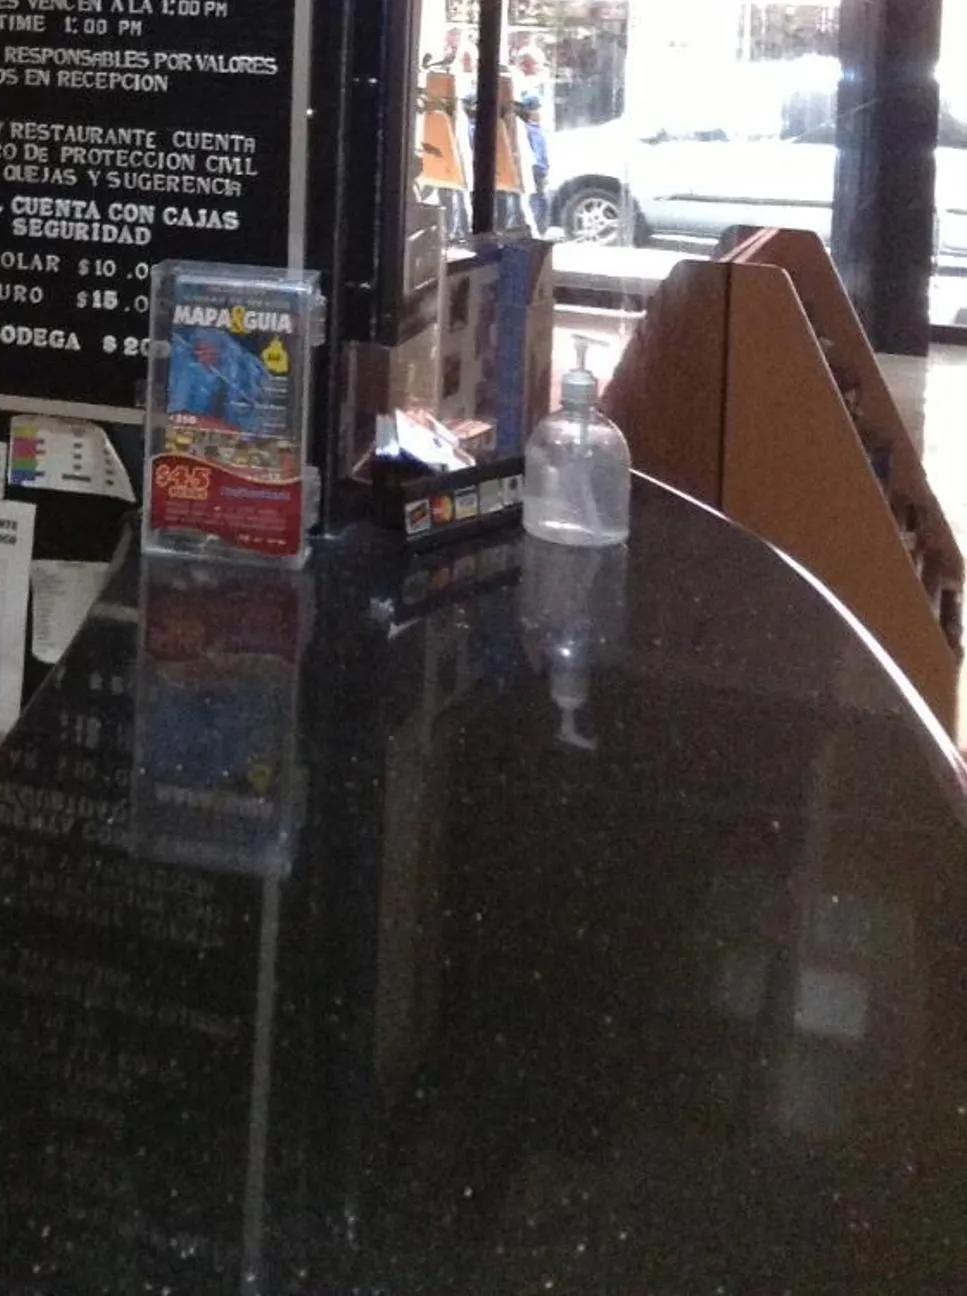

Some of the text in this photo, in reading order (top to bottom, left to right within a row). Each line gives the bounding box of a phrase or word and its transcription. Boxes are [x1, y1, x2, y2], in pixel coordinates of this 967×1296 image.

[204, 1, 228, 17] PM
[119, 20, 143, 36] PM
[4, 44, 149, 69] RESPONSABLES
[154, 53, 194, 72] POR
[196, 54, 277, 75] VALORES
[25, 67, 51, 86] EN
[57, 70, 169, 92] RECEPCION
[10, 122, 157, 149] RESTAURANTE
[172, 131, 256, 154] CUENTA
[24, 142, 48, 162] DE
[60, 146, 195, 172] PROTECCION
[3, 163, 77, 186] QUEJAS
[87, 168, 103, 187] Y
[105, 170, 242, 196] SUGERENCIA
[10, 193, 101, 219] CUENTA
[108, 202, 155, 224] CON
[162, 205, 240, 230] CAJAS
[13, 217, 152, 244] SEGURIDAD
